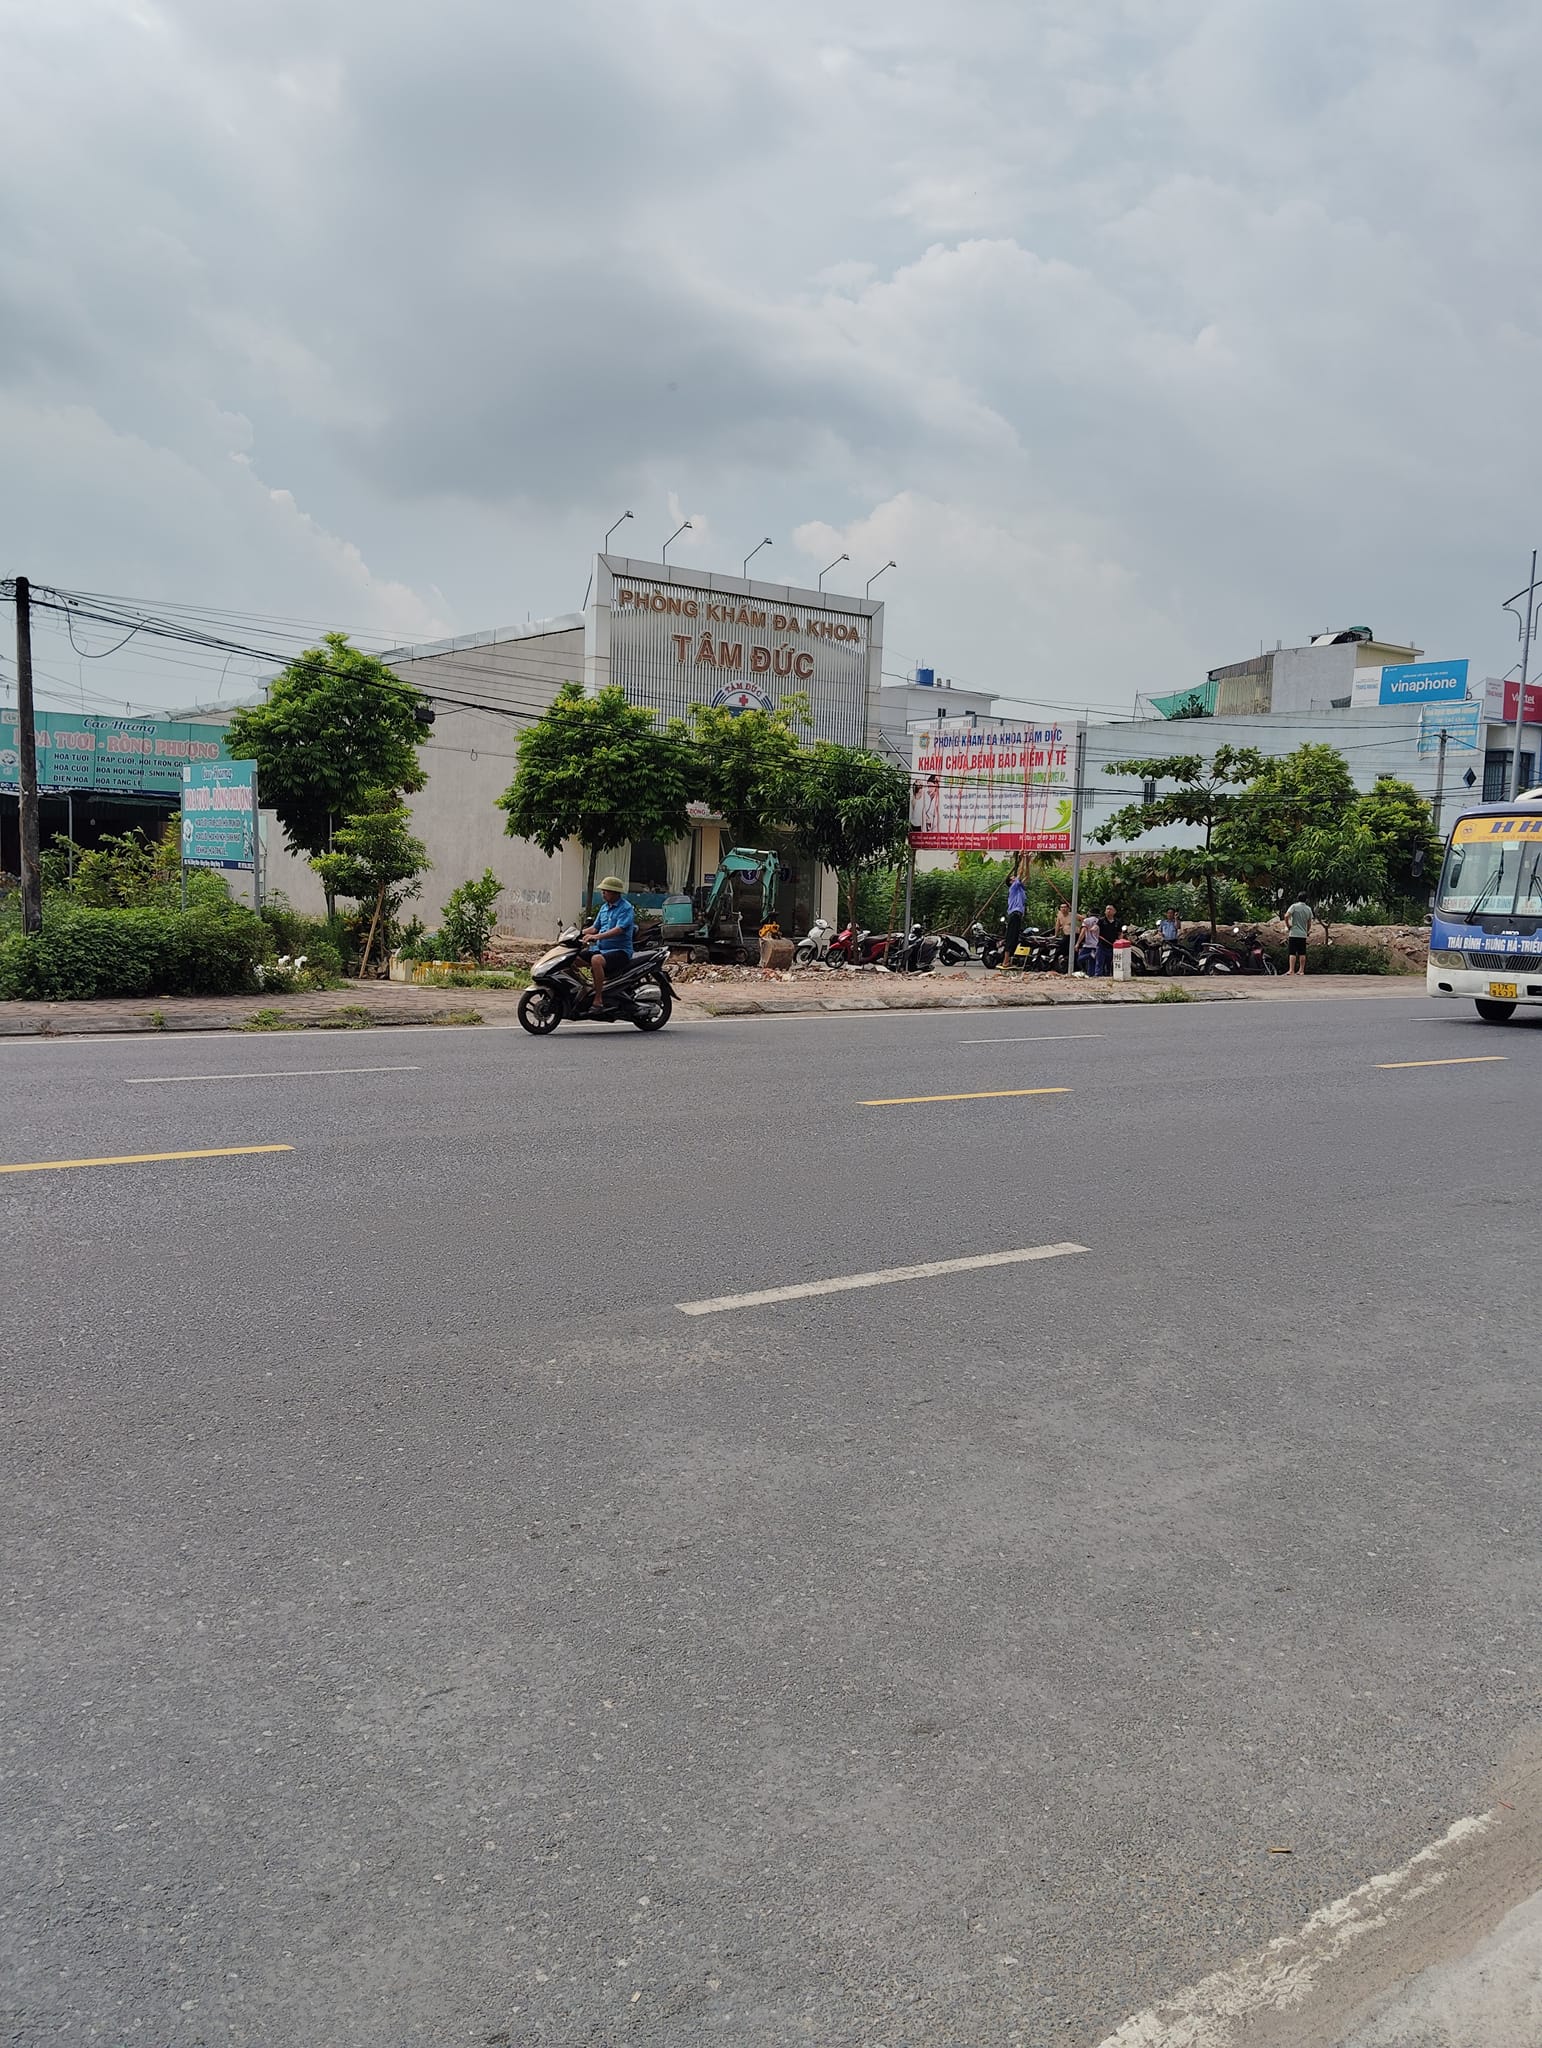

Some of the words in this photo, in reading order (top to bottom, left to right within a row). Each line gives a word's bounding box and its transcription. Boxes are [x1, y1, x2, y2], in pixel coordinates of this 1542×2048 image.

[618, 588, 698, 618] PHÒNG
[706, 603, 766, 629] KHÁM
[773, 614, 800, 634] ĐA
[806, 619, 860, 643] KHOA
[672, 631, 743, 670] TÂM
[750, 643, 815, 680] ĐỨC
[725, 682, 743, 693] TÂM
[1391, 677, 1457, 693] vinaphone
[83, 718, 108, 729] Cao
[961, 732, 985, 747] KHÁM
[1000, 732, 1021, 744] KHOA
[1024, 729, 1042, 743] TÂM
[1045, 728, 1063, 742] ĐỨC
[54, 731, 97, 752] TƯƠI
[155, 737, 219, 761] PHƯỢNG
[918, 753, 943, 771] KHÁM
[945, 751, 969, 770] CHỮA
[971, 751, 996, 770] BỆNH
[998, 746, 1017, 769] BẢO
[1019, 746, 1044, 767] HIỂM
[1047, 750, 1054, 766] Y
[1055, 746, 1067, 766] TẾ
[96, 766, 111, 774] HOA
[95, 777, 110, 785] HOA
[1447, 934, 1462, 949] THÁI
